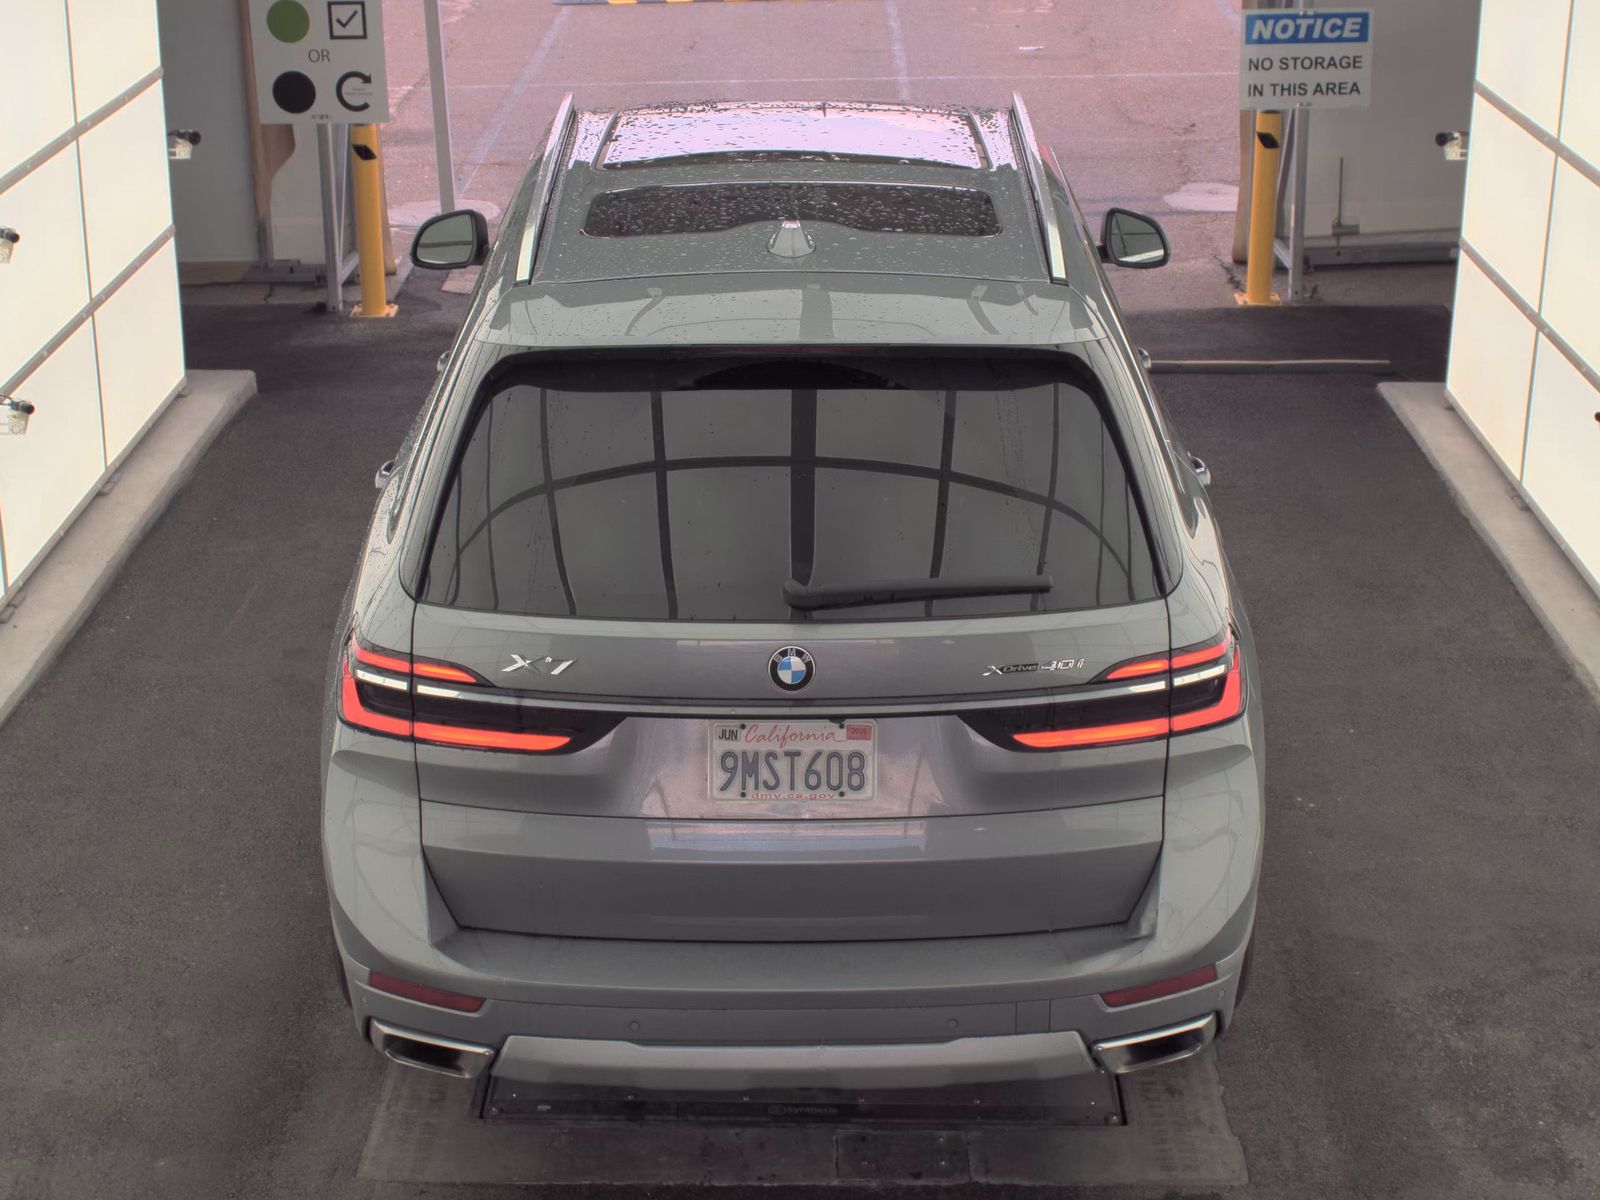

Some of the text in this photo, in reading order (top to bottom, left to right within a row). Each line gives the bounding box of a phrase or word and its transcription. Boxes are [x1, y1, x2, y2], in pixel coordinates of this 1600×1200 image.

[1252, 17, 1362, 40] NOTICE
[307, 48, 331, 63] OR
[1248, 55, 1363, 71] NO STORAGE
[1248, 81, 1361, 97] IN THIS AREA
[773, 648, 811, 663] BMW
[501, 654, 576, 675] X7
[718, 728, 738, 741] JUN
[744, 723, 847, 749] California
[720, 751, 866, 792] 9MST608
[751, 791, 835, 801] dmv.ca.gov
